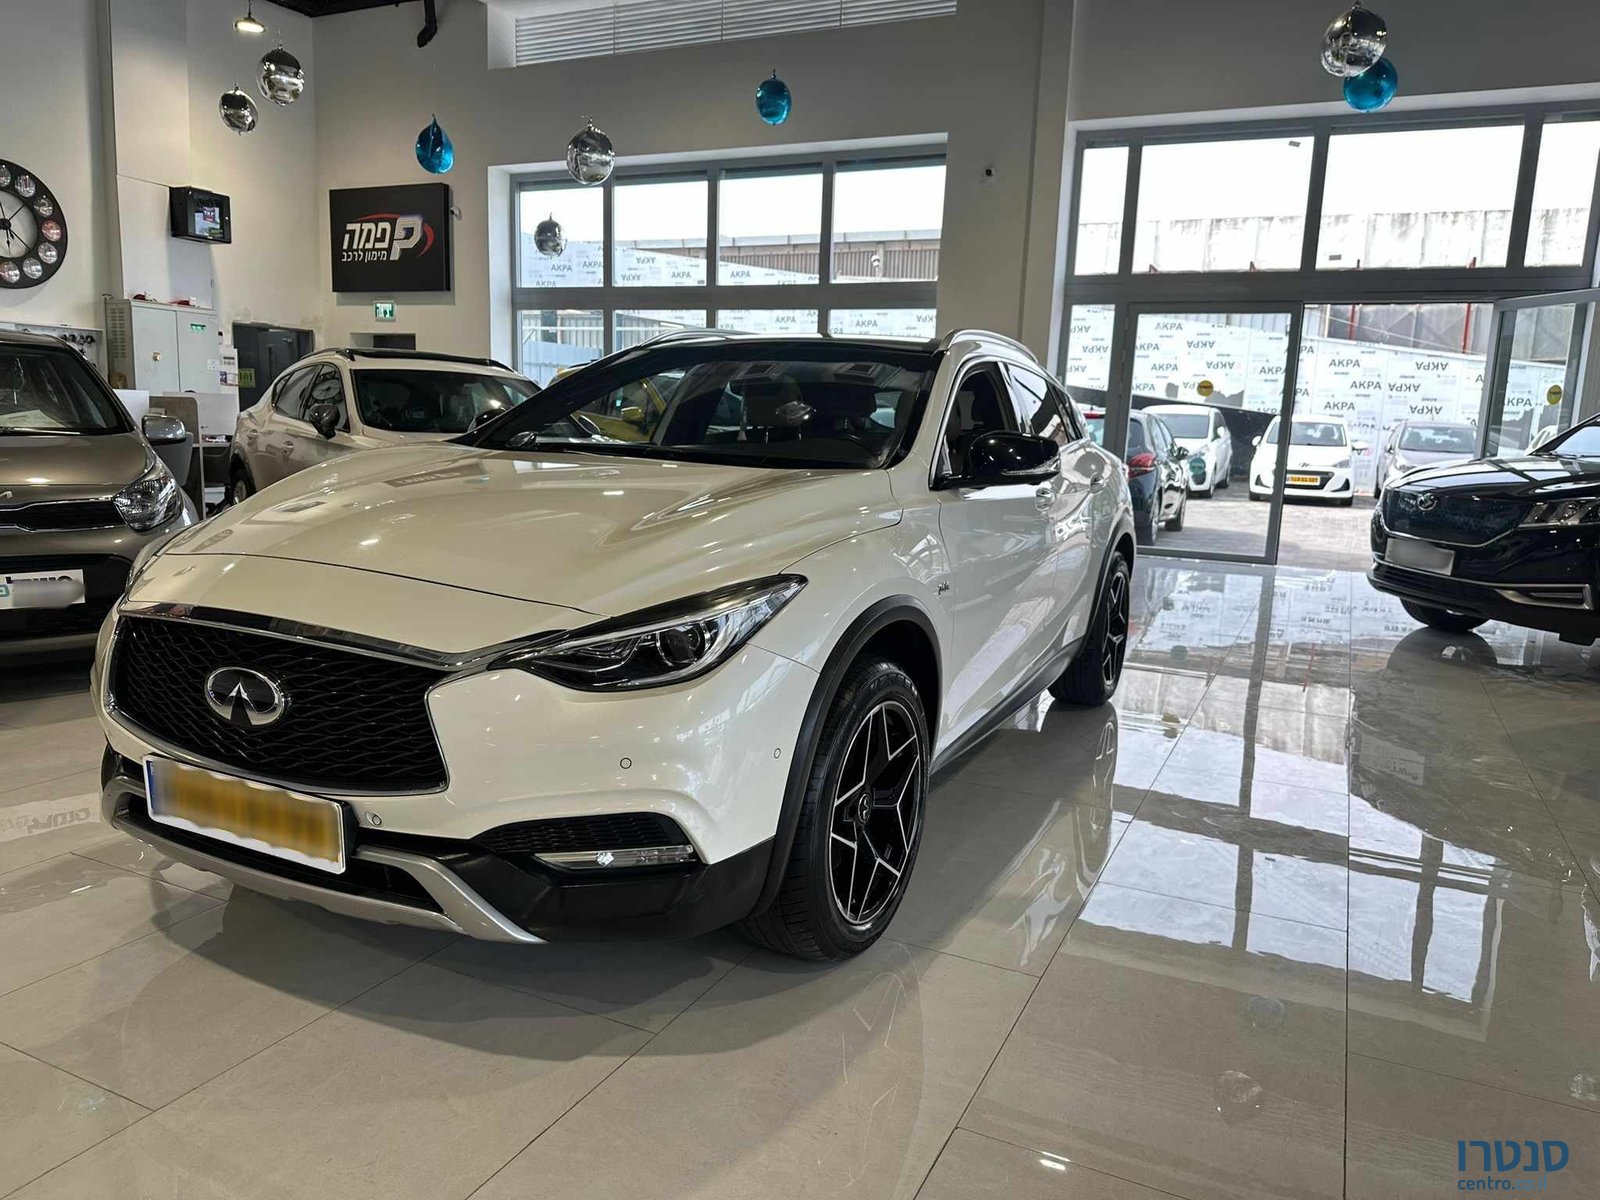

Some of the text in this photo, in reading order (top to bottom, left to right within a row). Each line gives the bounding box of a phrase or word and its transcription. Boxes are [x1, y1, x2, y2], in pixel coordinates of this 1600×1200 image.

[341, 249, 387, 263] מימון לרכב
[551, 263, 573, 272] AKPA
[671, 271, 691, 279] AKPA
[730, 270, 752, 279] AKPA
[774, 315, 797, 324] AKPA
[855, 319, 878, 328] AKPA
[1154, 322, 1183, 331] AKPA
[1082, 344, 1109, 353] AKPA
[1186, 340, 1215, 349] AKPA
[1150, 363, 1179, 371] AKPA
[1206, 361, 1235, 370] AKPA
[1329, 359, 1361, 368] AKPA
[1415, 361, 1449, 371] AKPA
[1350, 380, 1382, 390] AKPA
[1388, 382, 1421, 392] AKPA
[1323, 401, 1355, 411] AKPA
[1504, 397, 1532, 407] KPA
[1409, 405, 1443, 415] AKPA
